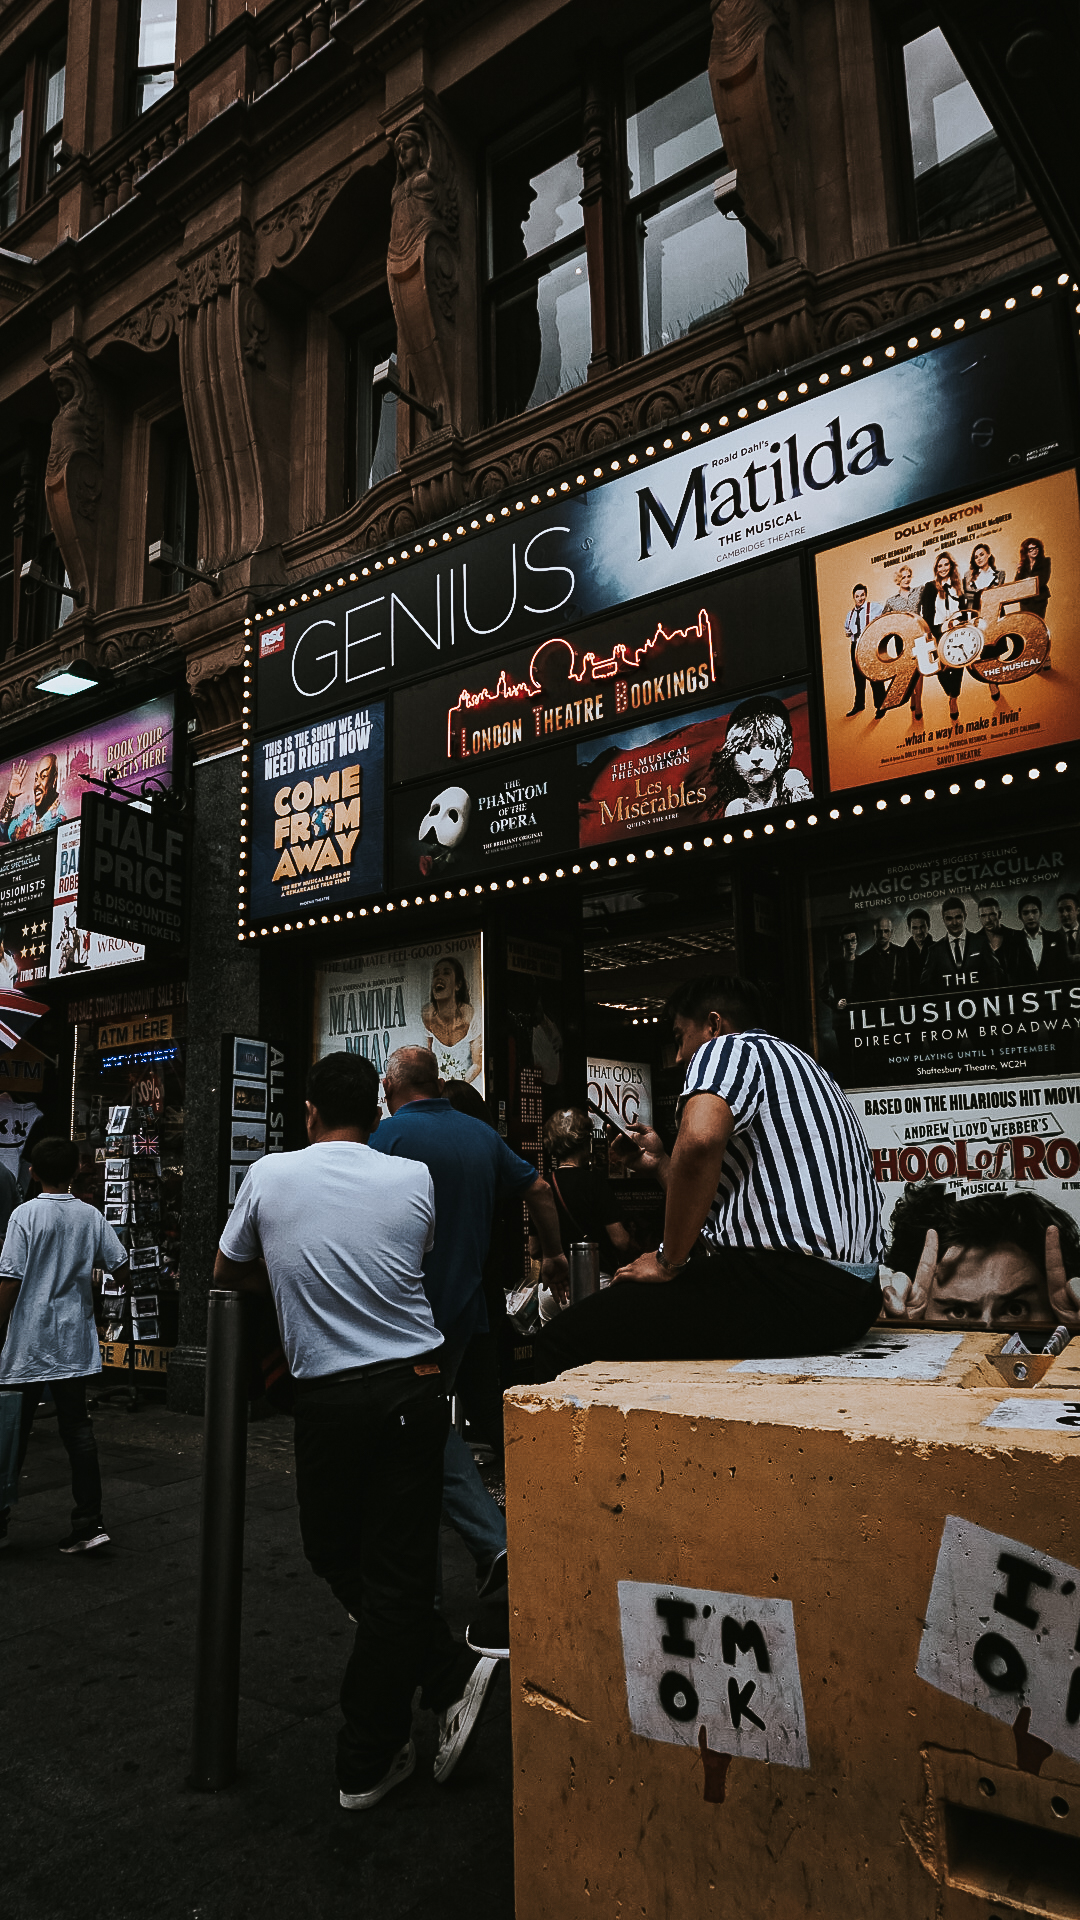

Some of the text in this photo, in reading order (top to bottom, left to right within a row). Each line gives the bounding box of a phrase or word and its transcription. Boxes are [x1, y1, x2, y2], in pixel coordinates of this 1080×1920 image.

[712, 440, 769, 468] Roald Dahl's
[635, 415, 895, 562] Matilda
[718, 511, 801, 546] THE MUSICAL
[894, 504, 983, 541] DOLLY PARTON
[716, 526, 806, 562] CAMBRIDGE THEATRE
[291, 527, 576, 696] GENIUS
[261, 627, 284, 648] RSC
[855, 611, 933, 711] 9
[966, 576, 1051, 685] 5
[983, 657, 1042, 677] THE MUSICAL
[461, 662, 709, 758] LONDON THEATRE BOOKINGS
[928, 731, 933, 741] a
[936, 726, 953, 741] way
[955, 722, 964, 736] to
[966, 716, 990, 733] make
[991, 717, 998, 727] a
[999, 707, 1022, 726] livin'
[107, 726, 163, 763] BOOK YOUR
[284, 737, 293, 750] IS
[294, 730, 310, 748] THE
[311, 721, 337, 743] SHOW
[338, 716, 353, 734] WE
[354, 709, 371, 729] ALL
[102, 745, 167, 783] TKETS HERE
[264, 751, 295, 781] NEED
[298, 736, 336, 770] RIGHT
[611, 746, 690, 773] THE MUSICAL
[611, 755, 690, 782] PHENOMENON
[936, 753, 955, 766] SAVOY
[956, 747, 982, 762] THEATRE
[274, 764, 361, 817] COME
[478, 781, 548, 811] PHANTOM
[504, 779, 521, 790] THE
[635, 778, 662, 800] Les
[499, 802, 528, 817] OF THE
[599, 780, 707, 826] Misérables
[96, 802, 184, 867] HALF
[274, 797, 361, 850] FROM
[490, 812, 538, 834] OPERA
[626, 813, 680, 829] QUEEN'S THEATRE
[272, 829, 361, 882] AWAY
[493, 836, 518, 847] BRILLIANT
[518, 831, 544, 841] ORIGINAL
[60, 849, 80, 878] BA
[94, 847, 183, 907] PRICE
[848, 851, 1066, 900] MAGIC SPECTACULAR
[887, 846, 1018, 875] BROADWAY'S BIGGEST SELLING
[0, 879, 46, 900] USIONISTS
[12, 874, 22, 882] THE
[854, 871, 1060, 909] RETURNS TO LONDON WITH AN ALL NEW SHOW
[92, 909, 181, 943] THEATRE TICKETS
[93, 891, 181, 928] & DISCOUNTED
[323, 962, 341, 973] THE
[342, 952, 386, 972] ULTIMATE
[942, 971, 980, 986] THE
[95, 993, 122, 1018] STUDENT
[123, 987, 155, 1013] DISCOUNT
[157, 983, 173, 1007] SALE
[329, 984, 407, 1036] MAMMA
[849, 987, 1080, 1030] ILLUSIONISTS
[100, 1019, 168, 1046] ATM HERE
[854, 1017, 1080, 1048] DIRECT FROM BROADWAY
[0, 1060, 42, 1079] ATM
[888, 1043, 1056, 1064] NOW PLAYING UNTIL 1 SEPTEMBER
[916, 1059, 1027, 1076] Shaftesbury Theatre, WC2H
[588, 1065, 643, 1084] THAT GOES
[269, 1046, 285, 1151] ALL SH
[587, 1081, 640, 1126] ONG
[864, 1098, 902, 1115] BASED
[904, 1096, 922, 1113] ON
[923, 1094, 948, 1112] THE
[949, 1090, 1017, 1110] HILARIOUS
[1018, 1088, 1042, 1107] HIT
[904, 1117, 1049, 1140] ANDREW LLOYD WEBBER'S
[873, 1135, 1080, 1183] HOOL of RO
[948, 1179, 1008, 1196] THE MUSICAL
[1061, 1182, 1068, 1190] AT
[99, 1345, 114, 1362] RE
[123, 1348, 154, 1367] ATM
[994, 1553, 1080, 1652] I'
[655, 1597, 771, 1674] I'M
[659, 1670, 766, 1731] OK
